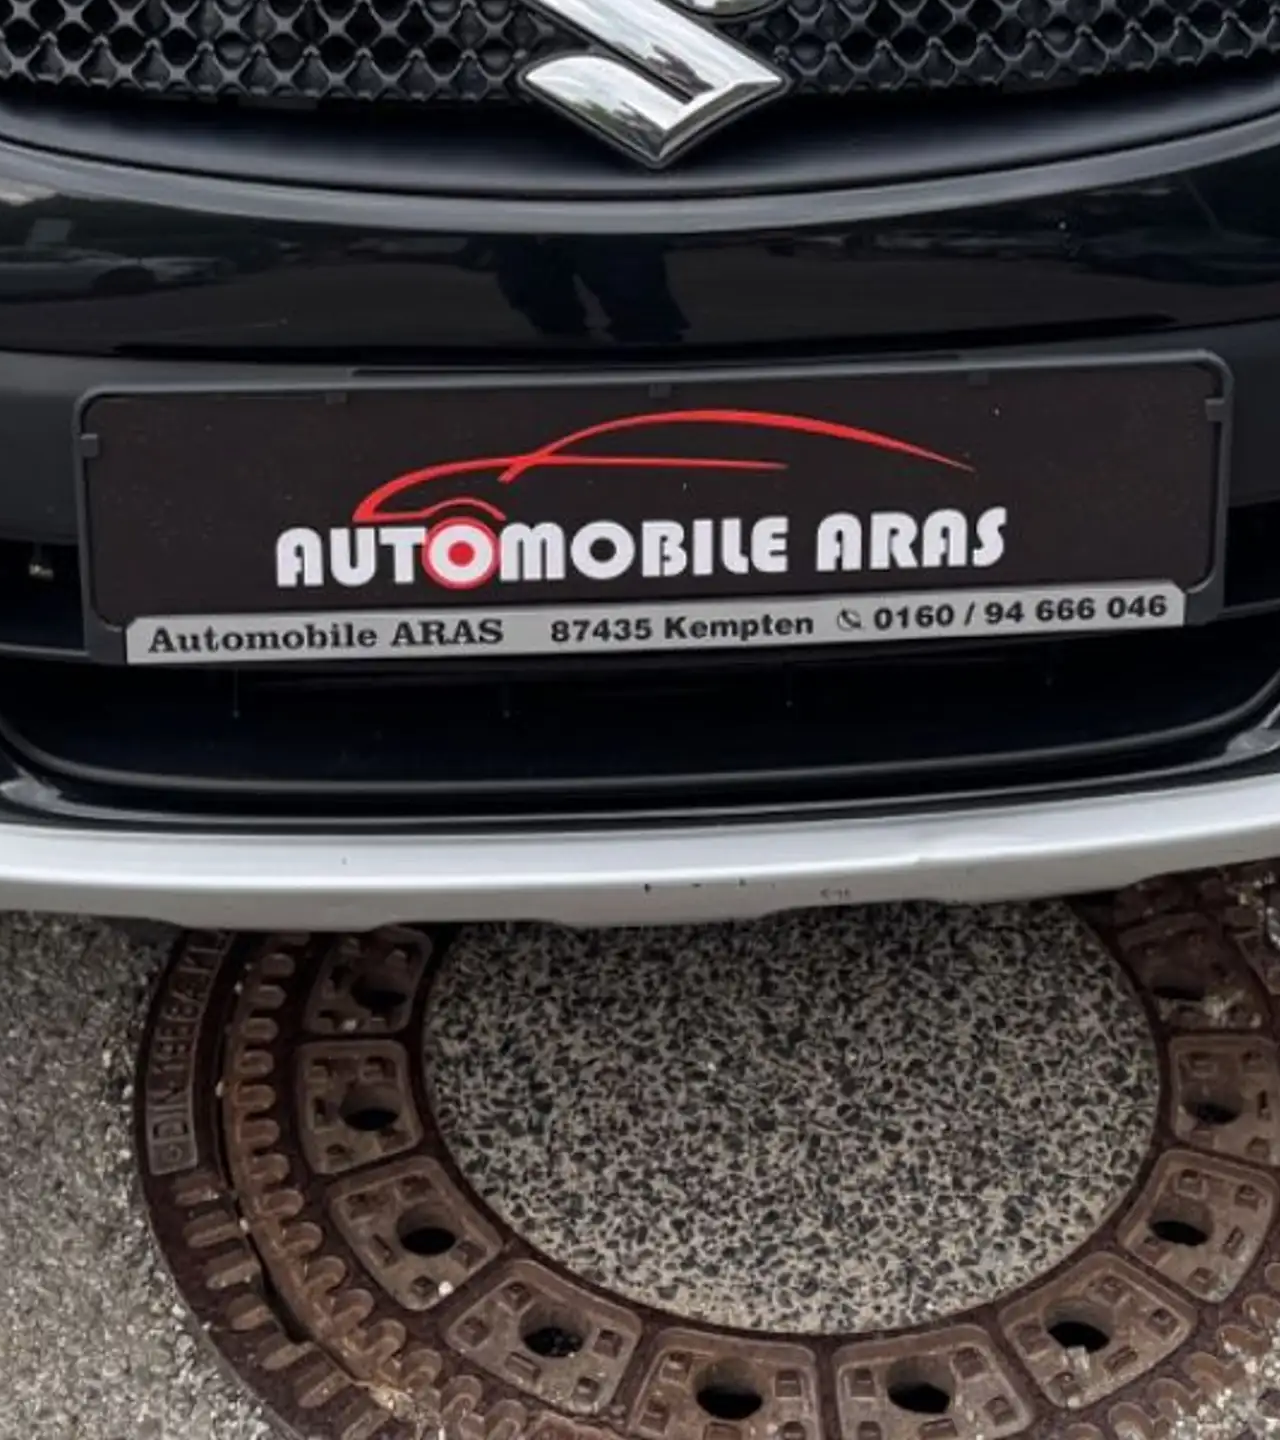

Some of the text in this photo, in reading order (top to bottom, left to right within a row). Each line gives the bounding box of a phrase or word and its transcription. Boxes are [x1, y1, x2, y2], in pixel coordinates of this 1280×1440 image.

[276, 506, 1007, 589] AUTOMOBILE ARAS
[148, 594, 1168, 654] Automobile ARAS 87435 Kempten 0160 / 94 666 046
